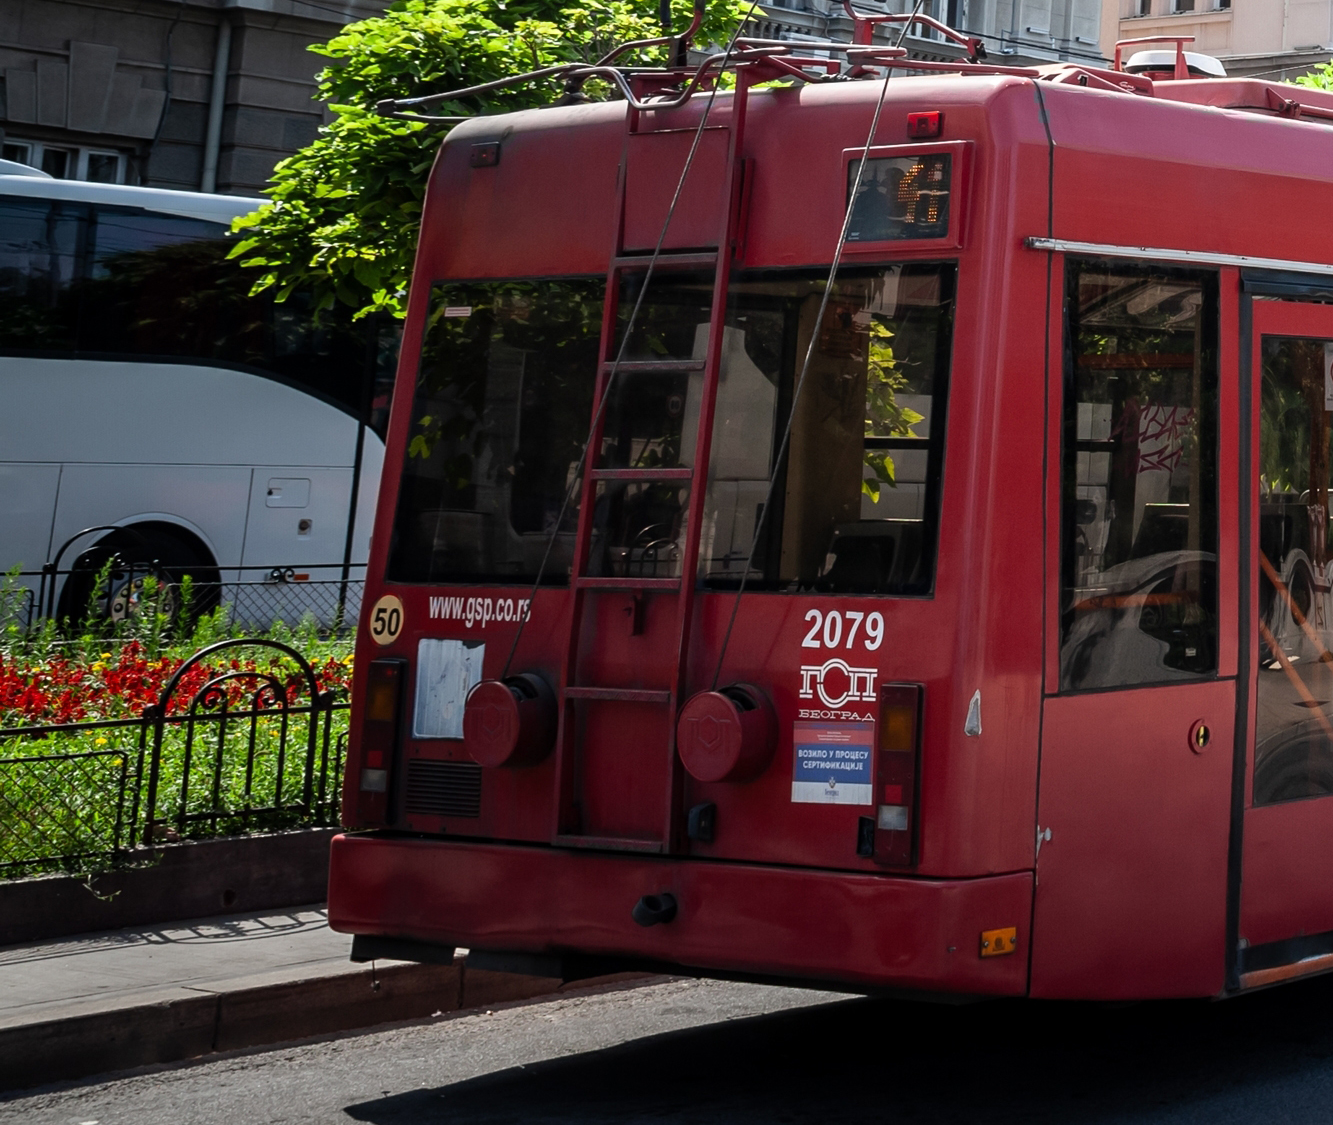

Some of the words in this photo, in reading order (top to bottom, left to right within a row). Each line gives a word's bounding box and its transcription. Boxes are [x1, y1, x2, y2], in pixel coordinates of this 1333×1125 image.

[373, 608, 401, 636] 50
[429, 596, 531, 628] www.gsp.co.rs
[801, 609, 885, 650] 2079
[798, 709, 875, 722] БЕОГРАД
[798, 749, 828, 758] ВОЗИЛО
[829, 750, 834, 758] У
[835, 750, 869, 760] ПРОЦЕСУ
[802, 760, 863, 771] СЕРТИФИКАЦИЈЕ
